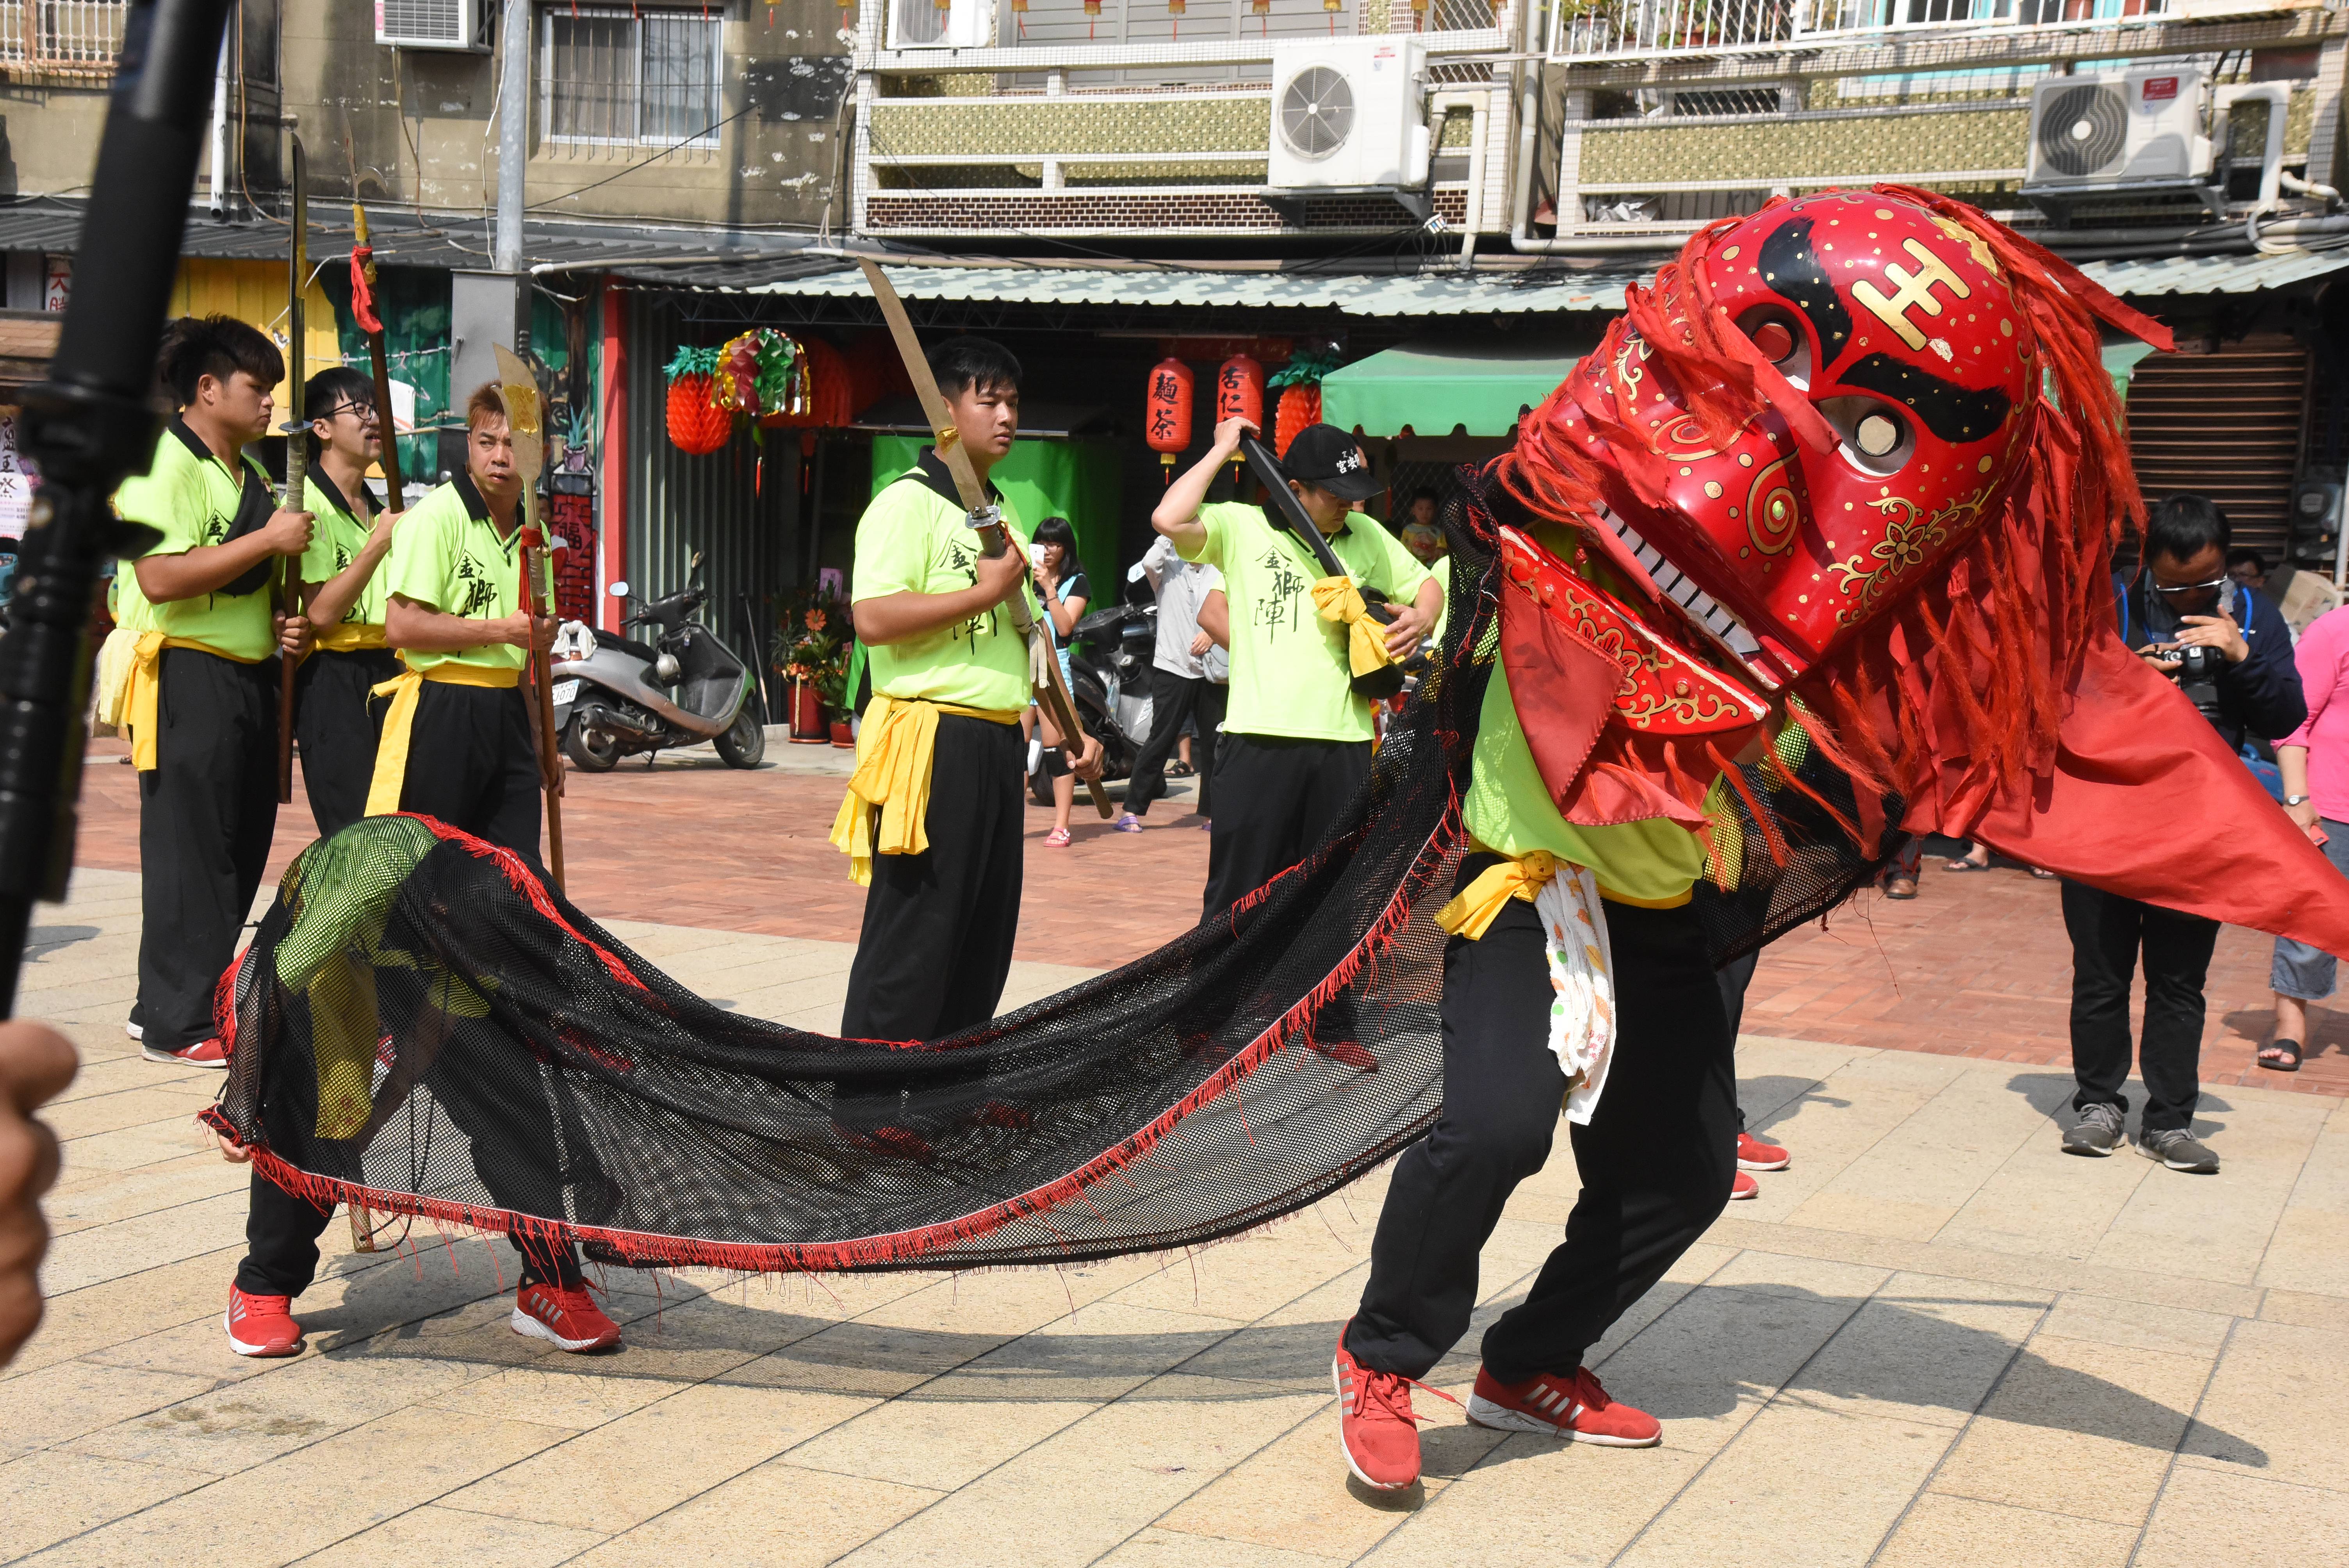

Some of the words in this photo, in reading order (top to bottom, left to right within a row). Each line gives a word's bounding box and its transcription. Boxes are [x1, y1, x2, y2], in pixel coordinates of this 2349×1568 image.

[1151, 372, 1178, 440] 麵茶
[1220, 366, 1244, 421] 杏仁
[451, 549, 498, 620] 金獅
[1255, 545, 1305, 645] 金獅陣
